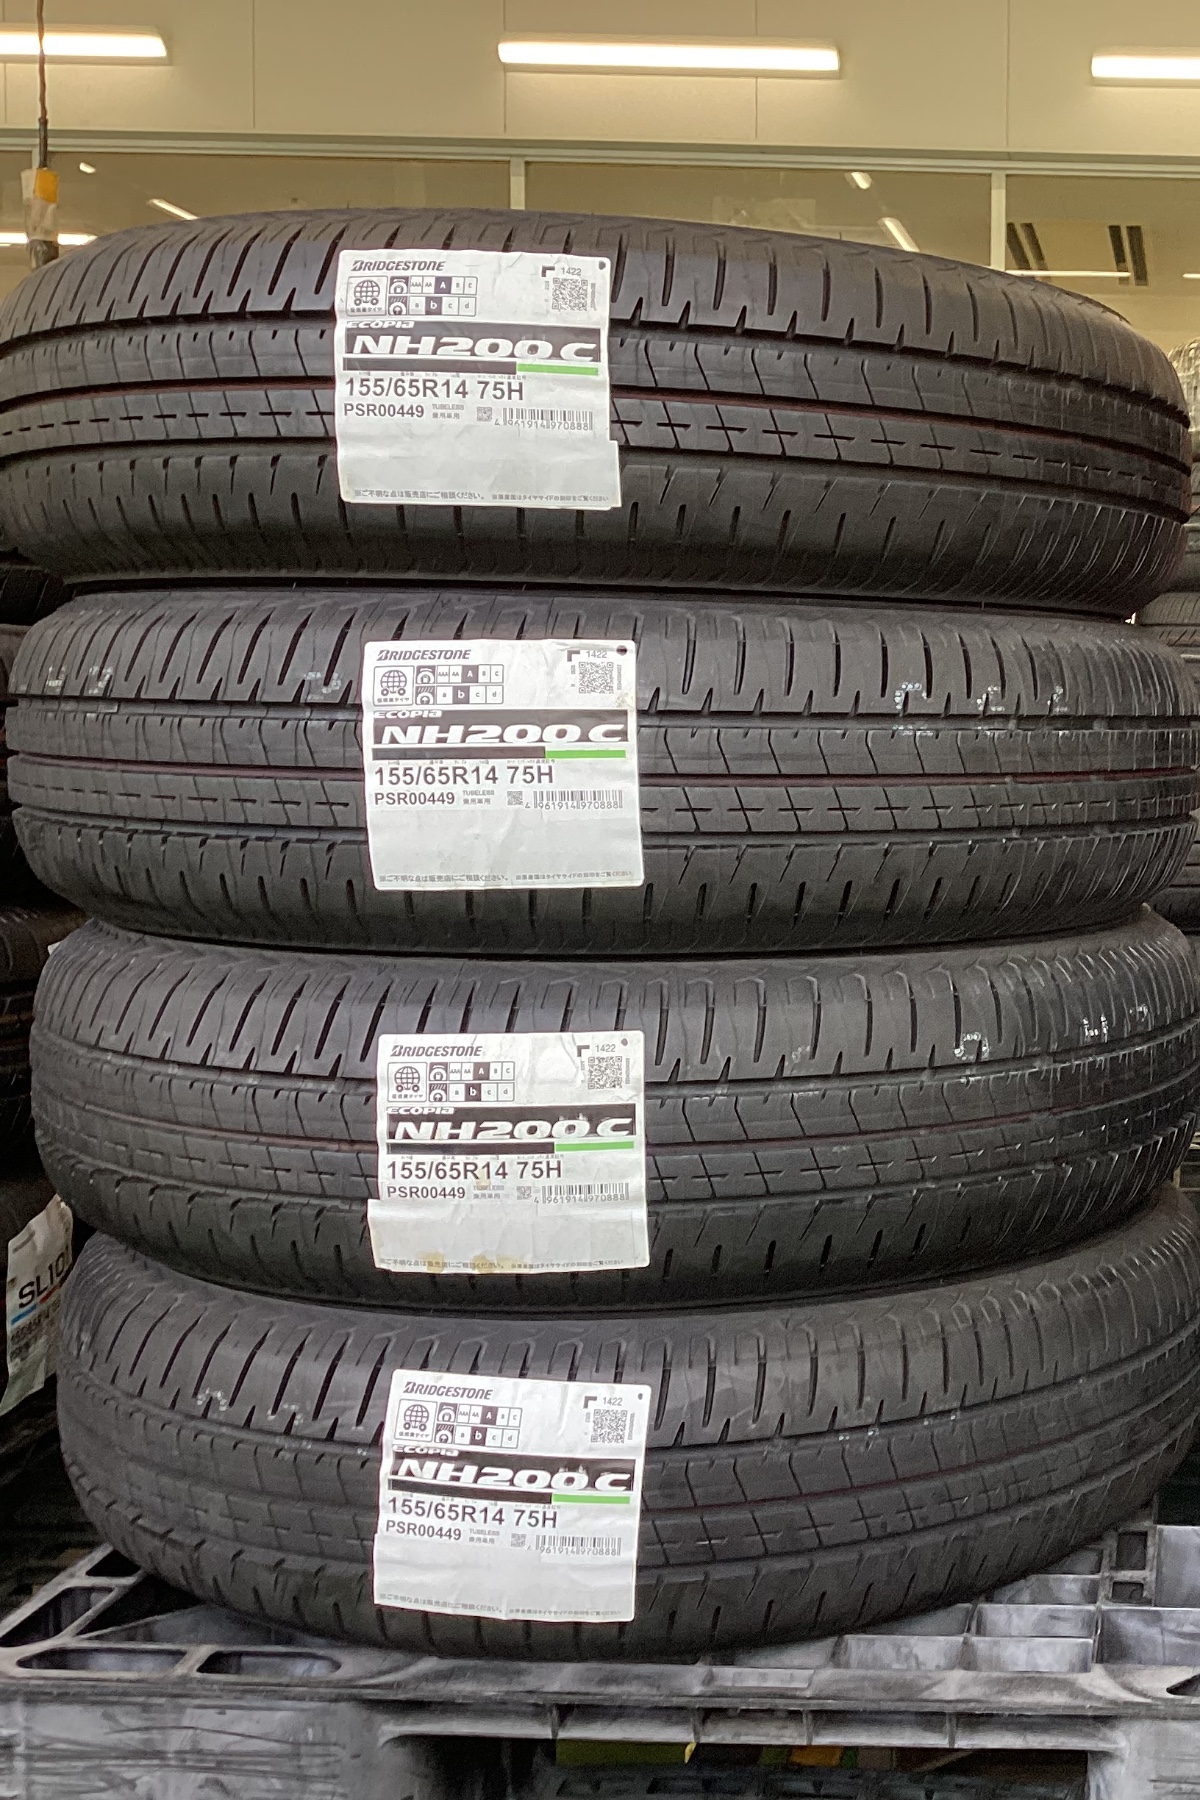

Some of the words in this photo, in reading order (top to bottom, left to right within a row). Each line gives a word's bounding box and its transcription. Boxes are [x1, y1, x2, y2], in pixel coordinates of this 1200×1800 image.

[350, 260, 445, 272] BRIDGESTONE
[561, 267, 582, 276] 1422
[440, 281, 446, 289] A
[430, 301, 437, 310] b
[346, 378, 468, 398] 155/65R14
[477, 381, 524, 400] 75H
[344, 403, 424, 418] PSR00449
[377, 650, 471, 661] BRIDGESTONE
[587, 650, 607, 658] 1422
[467, 670, 473, 678] A
[458, 690, 464, 698] b
[375, 766, 498, 786] 155/65R14
[507, 765, 553, 784] 75H
[375, 792, 455, 805] PSR00449
[390, 1046, 482, 1057] BRIDGESTONE
[595, 1044, 616, 1053] 1422
[478, 1068, 484, 1076] A
[470, 1088, 476, 1096] b
[388, 1161, 508, 1179] 155/65R14
[517, 1160, 562, 1178] 75H
[387, 1186, 465, 1199] PSR00449
[403, 1382, 493, 1400] BRIDGESTONE
[603, 1397, 623, 1405] 1422
[475, 1432, 482, 1440] b
[388, 1497, 505, 1525] 155/65R14
[514, 1510, 557, 1528] 75H
[386, 1520, 462, 1540] PSR00449
